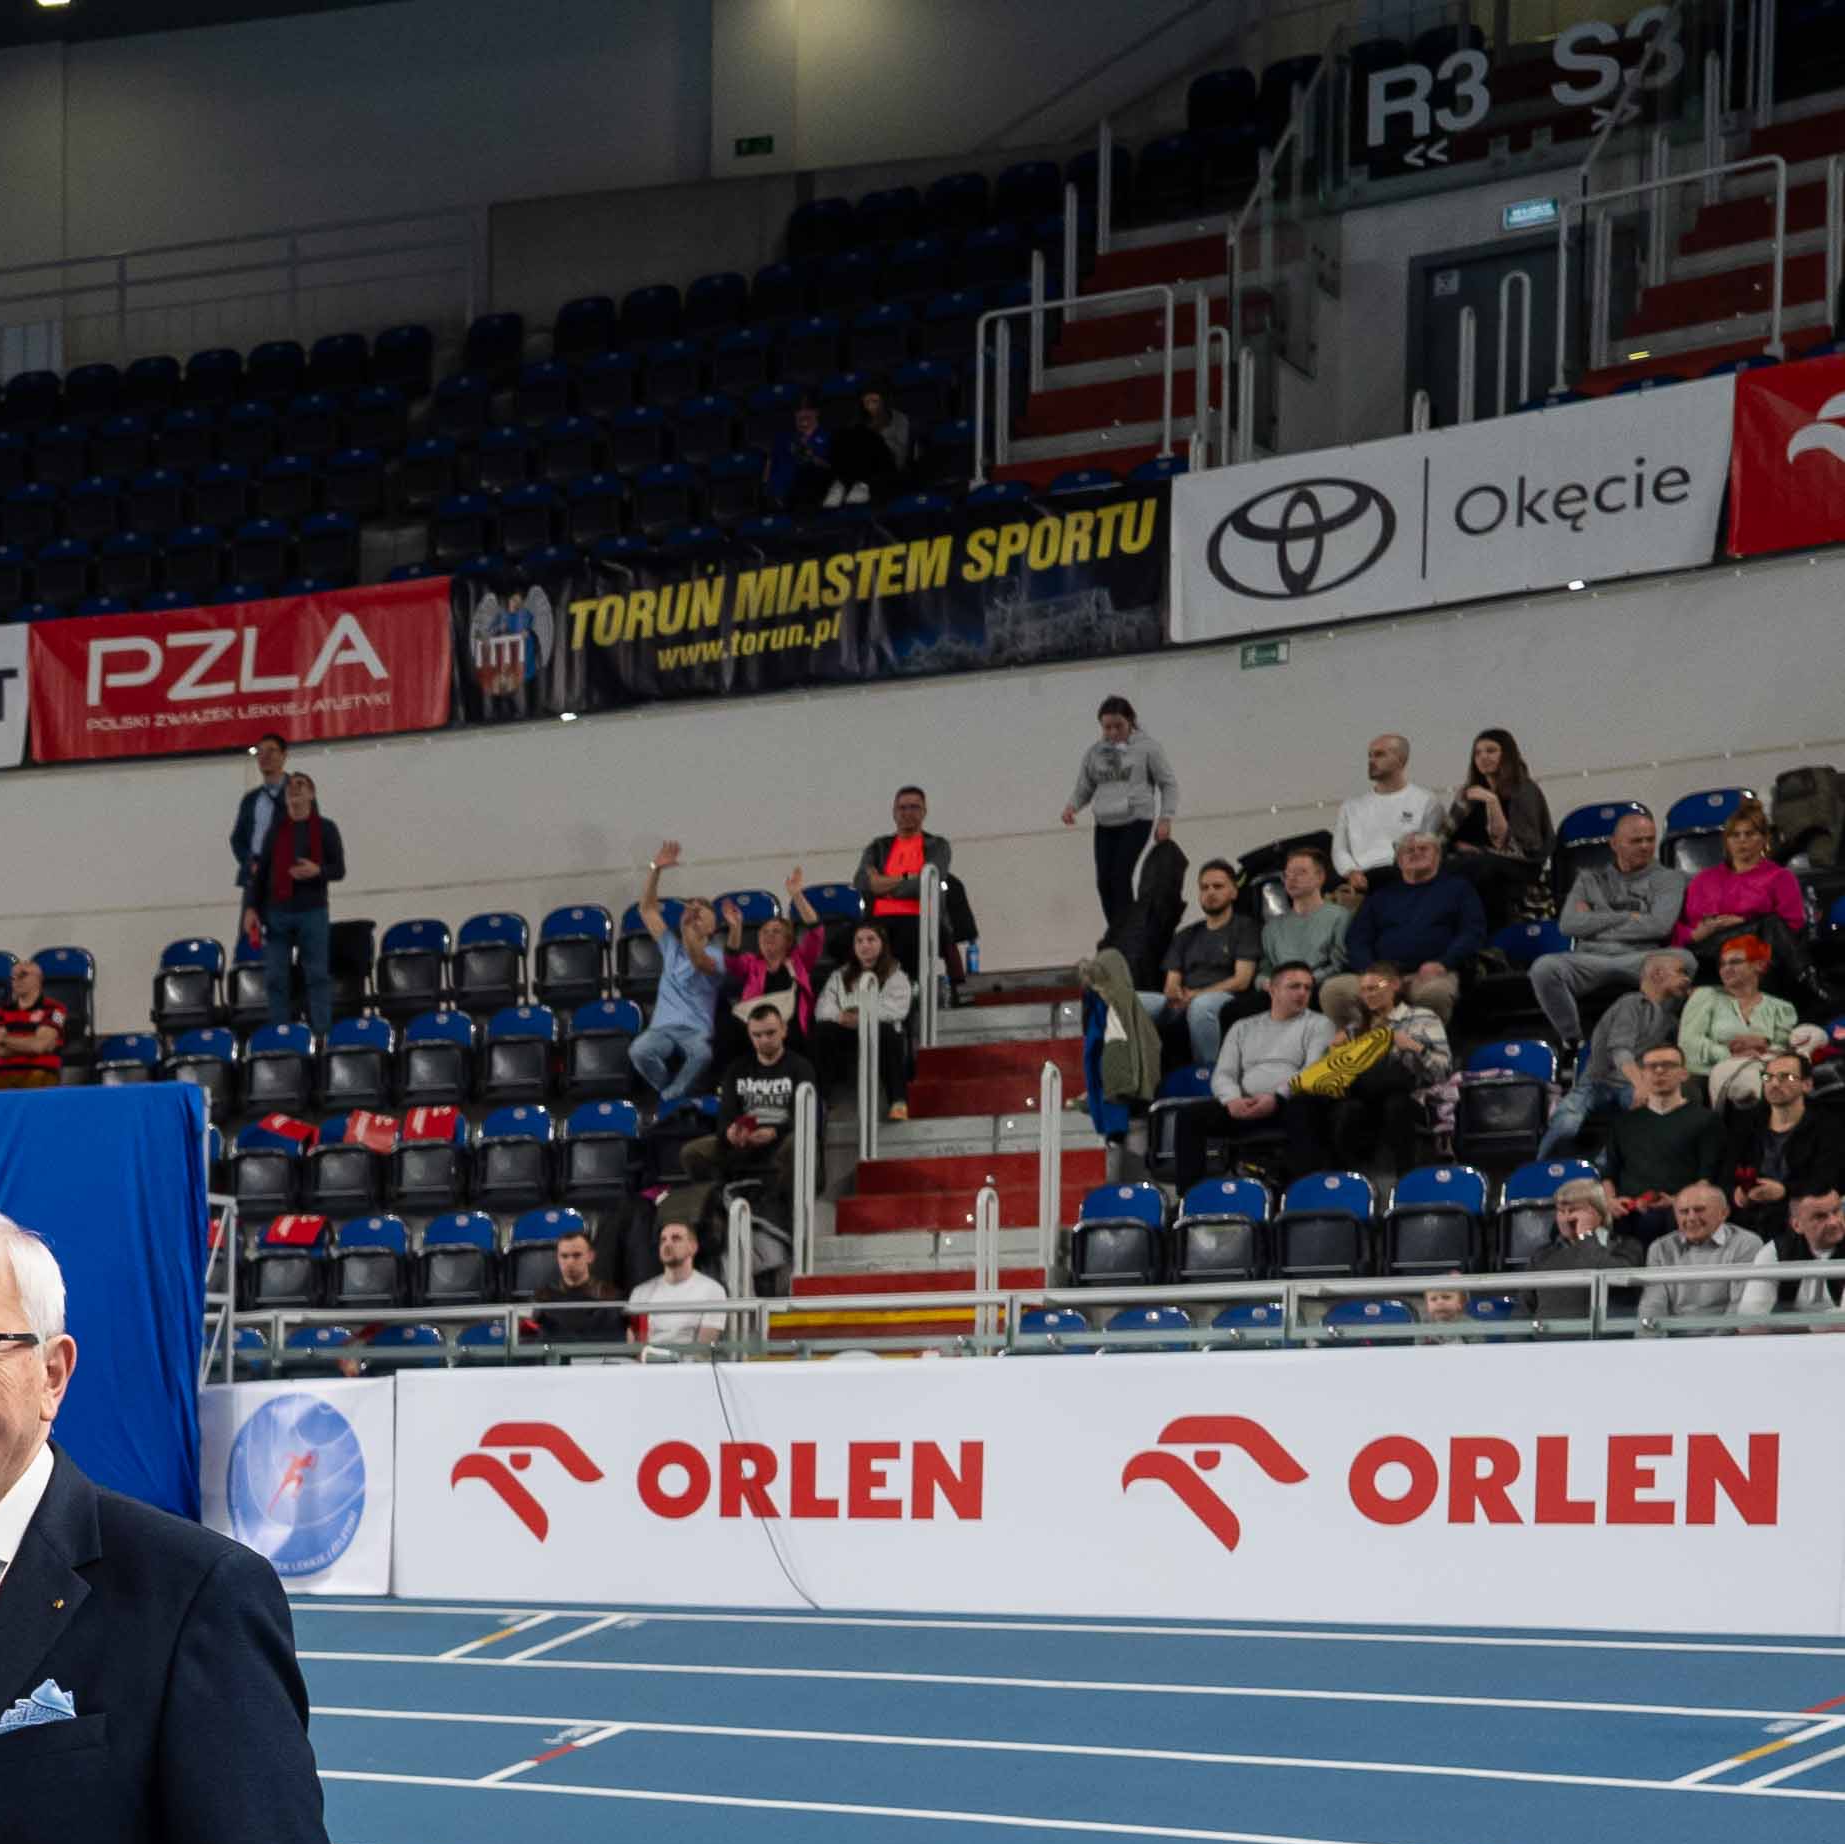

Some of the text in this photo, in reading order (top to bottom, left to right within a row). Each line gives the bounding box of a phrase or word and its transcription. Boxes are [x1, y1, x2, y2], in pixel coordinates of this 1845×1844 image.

[1367, 48, 1491, 148] R3
[1552, 8, 1686, 107] S3
[1454, 457, 1691, 537] Okęcie
[568, 498, 1158, 650] TORUŃ MIASTEM SPORTU
[87, 612, 388, 706] PZLA
[656, 614, 841, 672] www.torun.pl
[86, 716, 151, 731] POLSKI
[237, 703, 309, 720] LEKKIEJ
[312, 692, 391, 714] ATLETYKI
[637, 1440, 985, 1521] ORLEN
[1348, 1432, 1780, 1526] ORLEN
